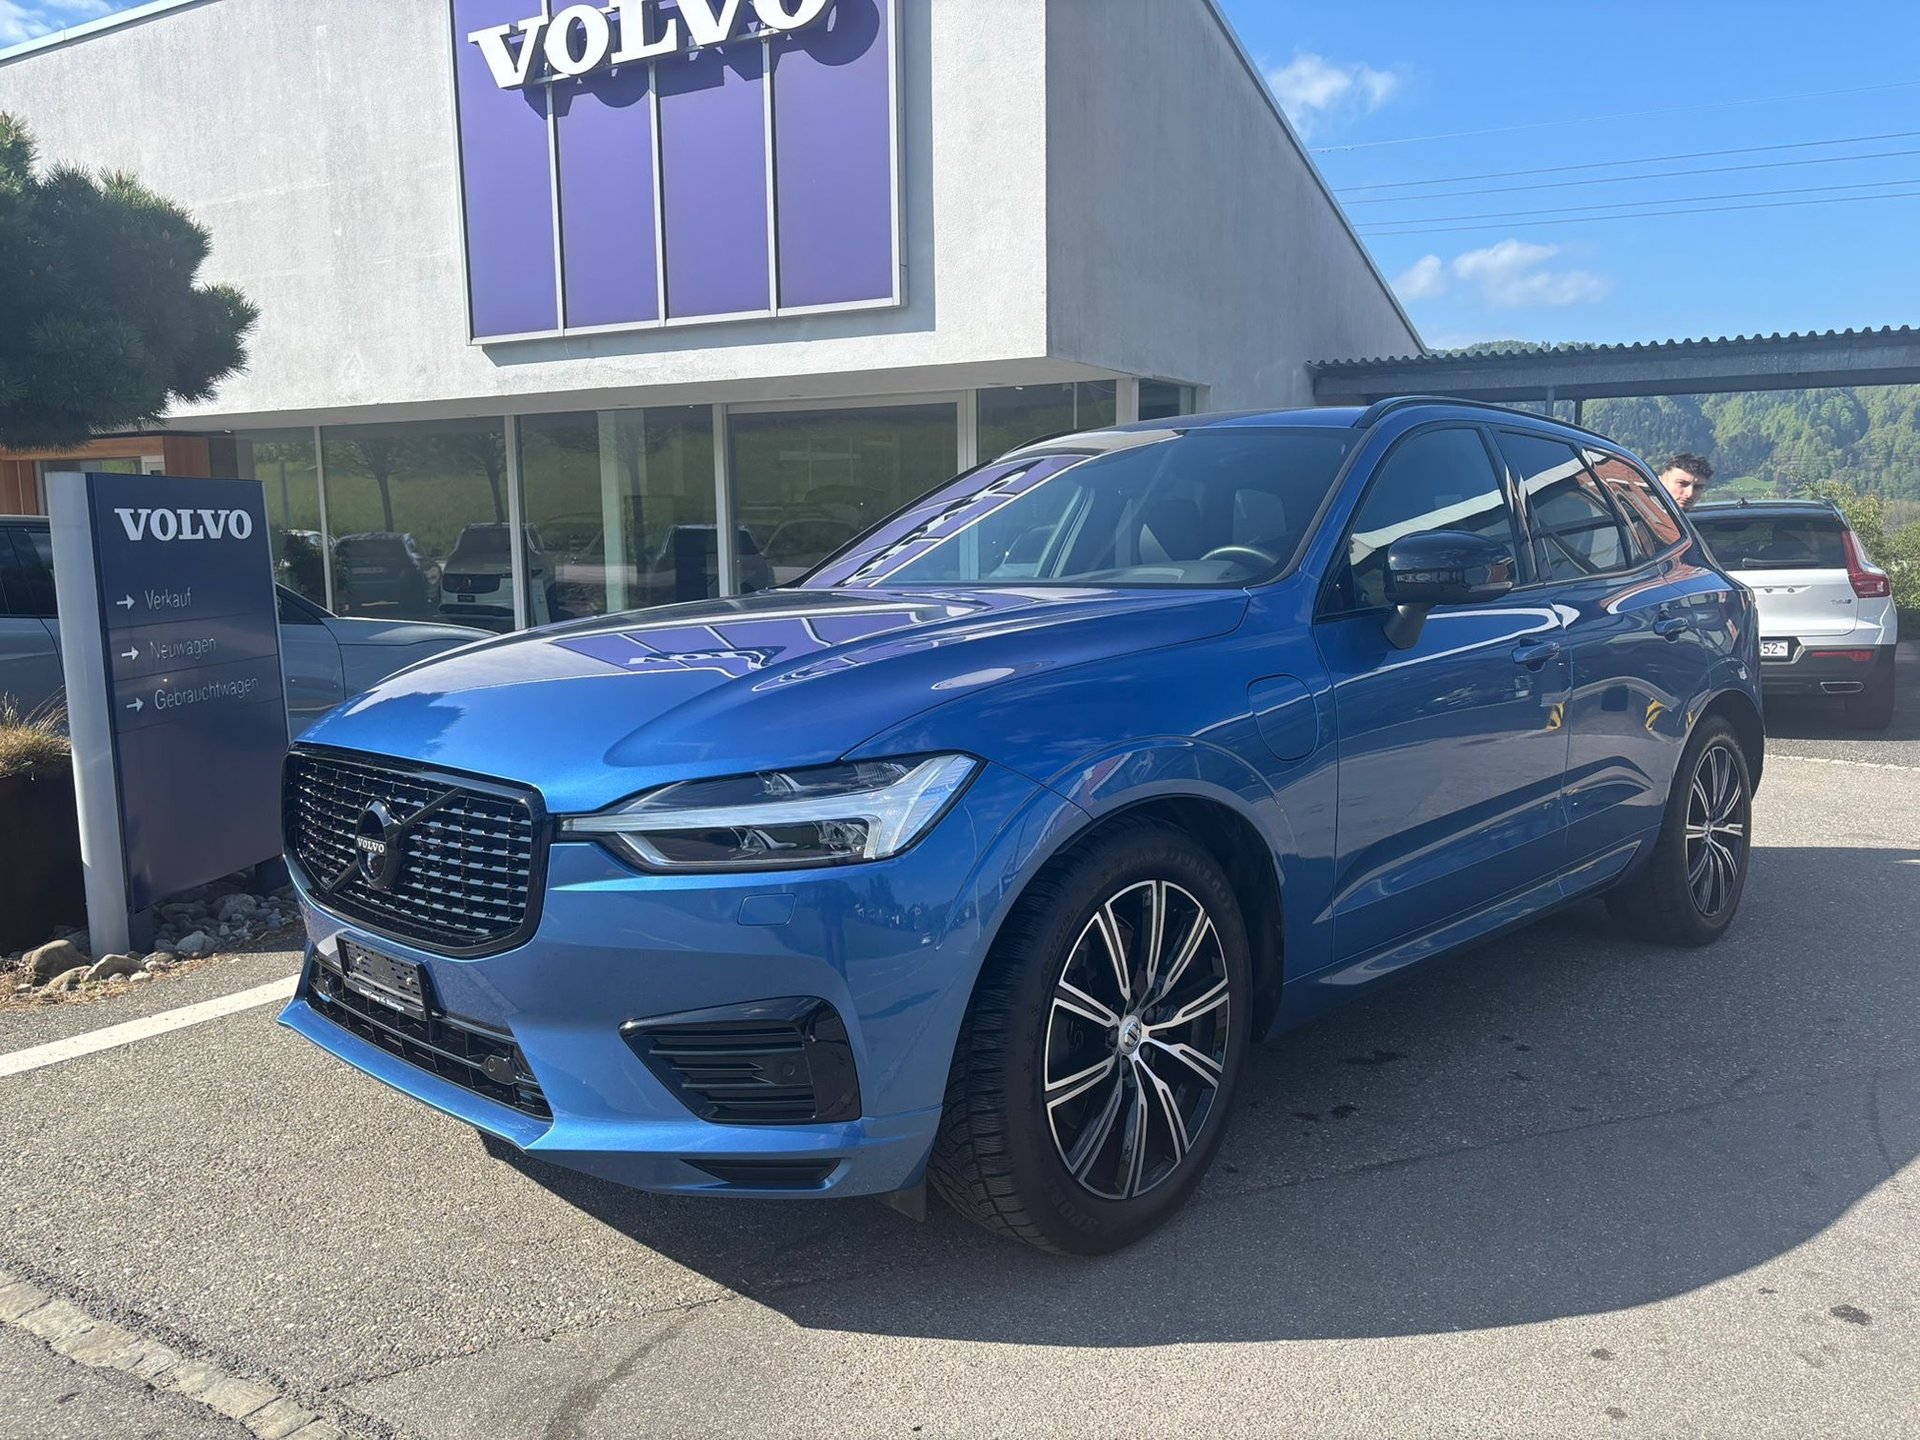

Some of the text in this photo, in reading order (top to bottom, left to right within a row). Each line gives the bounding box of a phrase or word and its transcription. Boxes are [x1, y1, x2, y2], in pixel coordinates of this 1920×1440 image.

[114, 508, 253, 541] VOLVO
[145, 587, 192, 610] Verkauf
[150, 637, 217, 659] Neuwagen
[154, 676, 258, 710] Gebrauchtwagen
[356, 837, 385, 853] VOLVO
